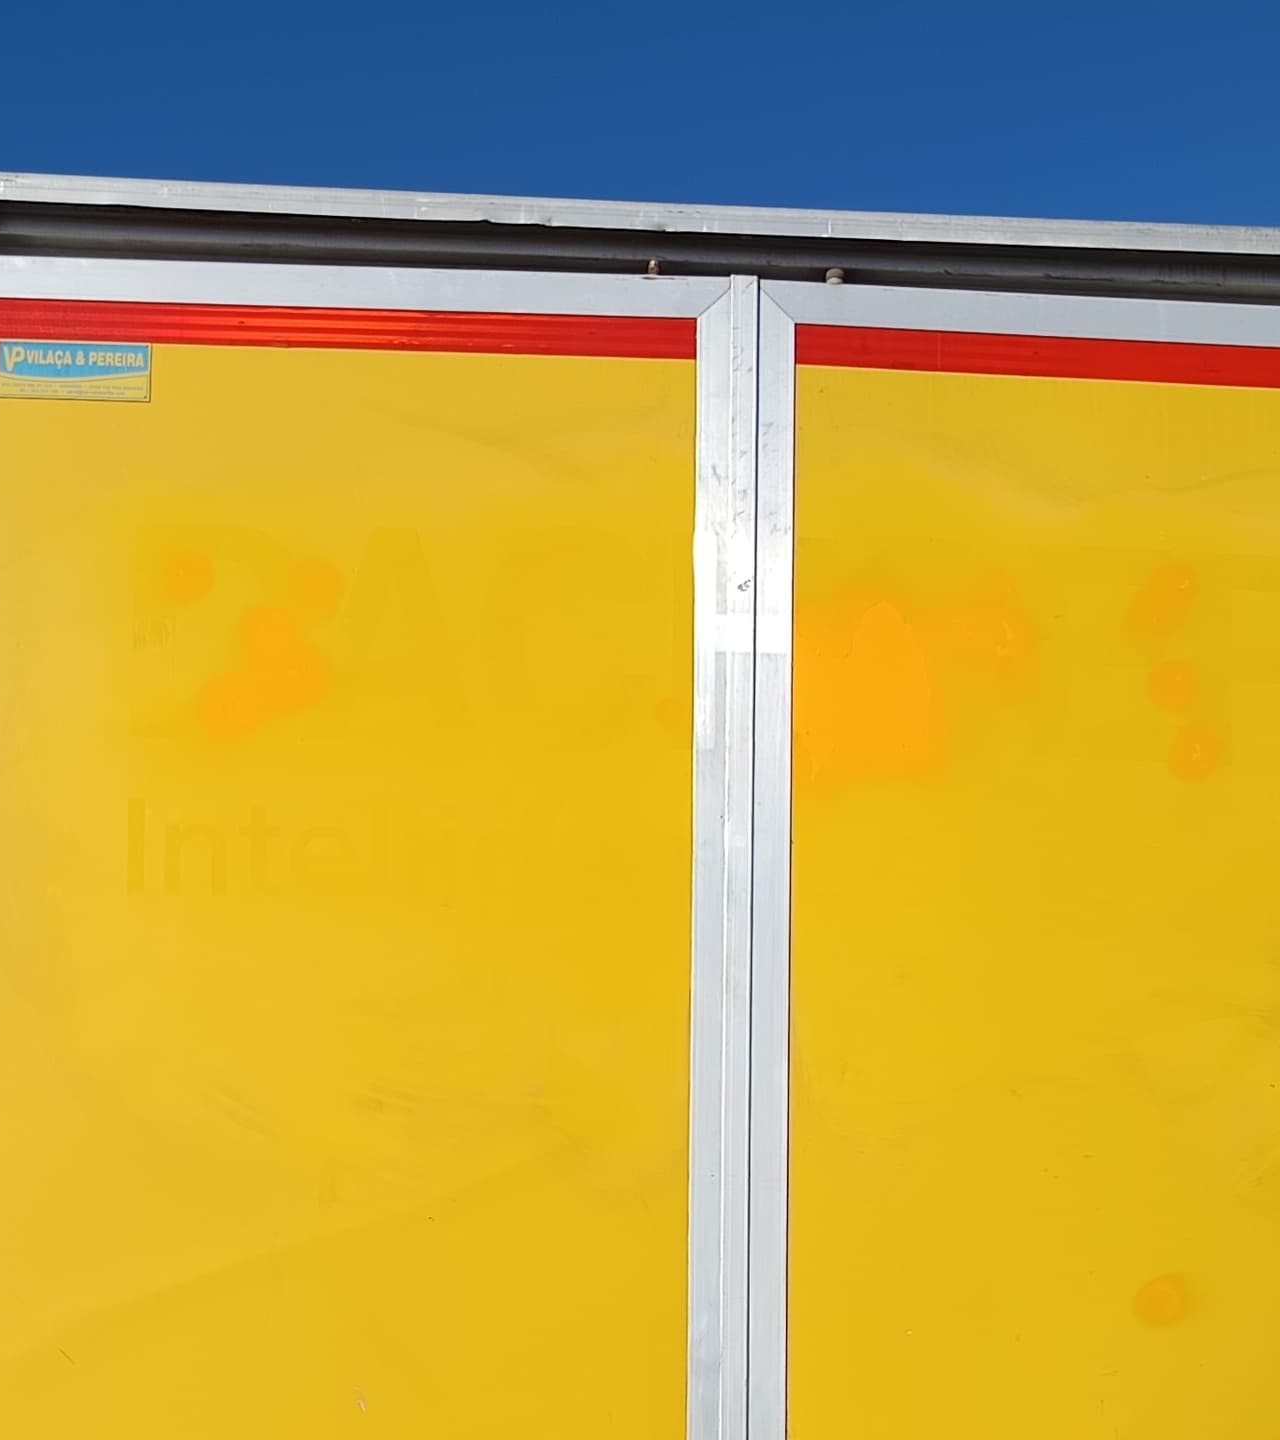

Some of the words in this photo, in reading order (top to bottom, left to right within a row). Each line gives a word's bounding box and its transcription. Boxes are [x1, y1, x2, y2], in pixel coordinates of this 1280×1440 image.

[26, 350, 71, 369] VILAÇA
[75, 350, 85, 366] &
[89, 352, 144, 367] PEREIRA
